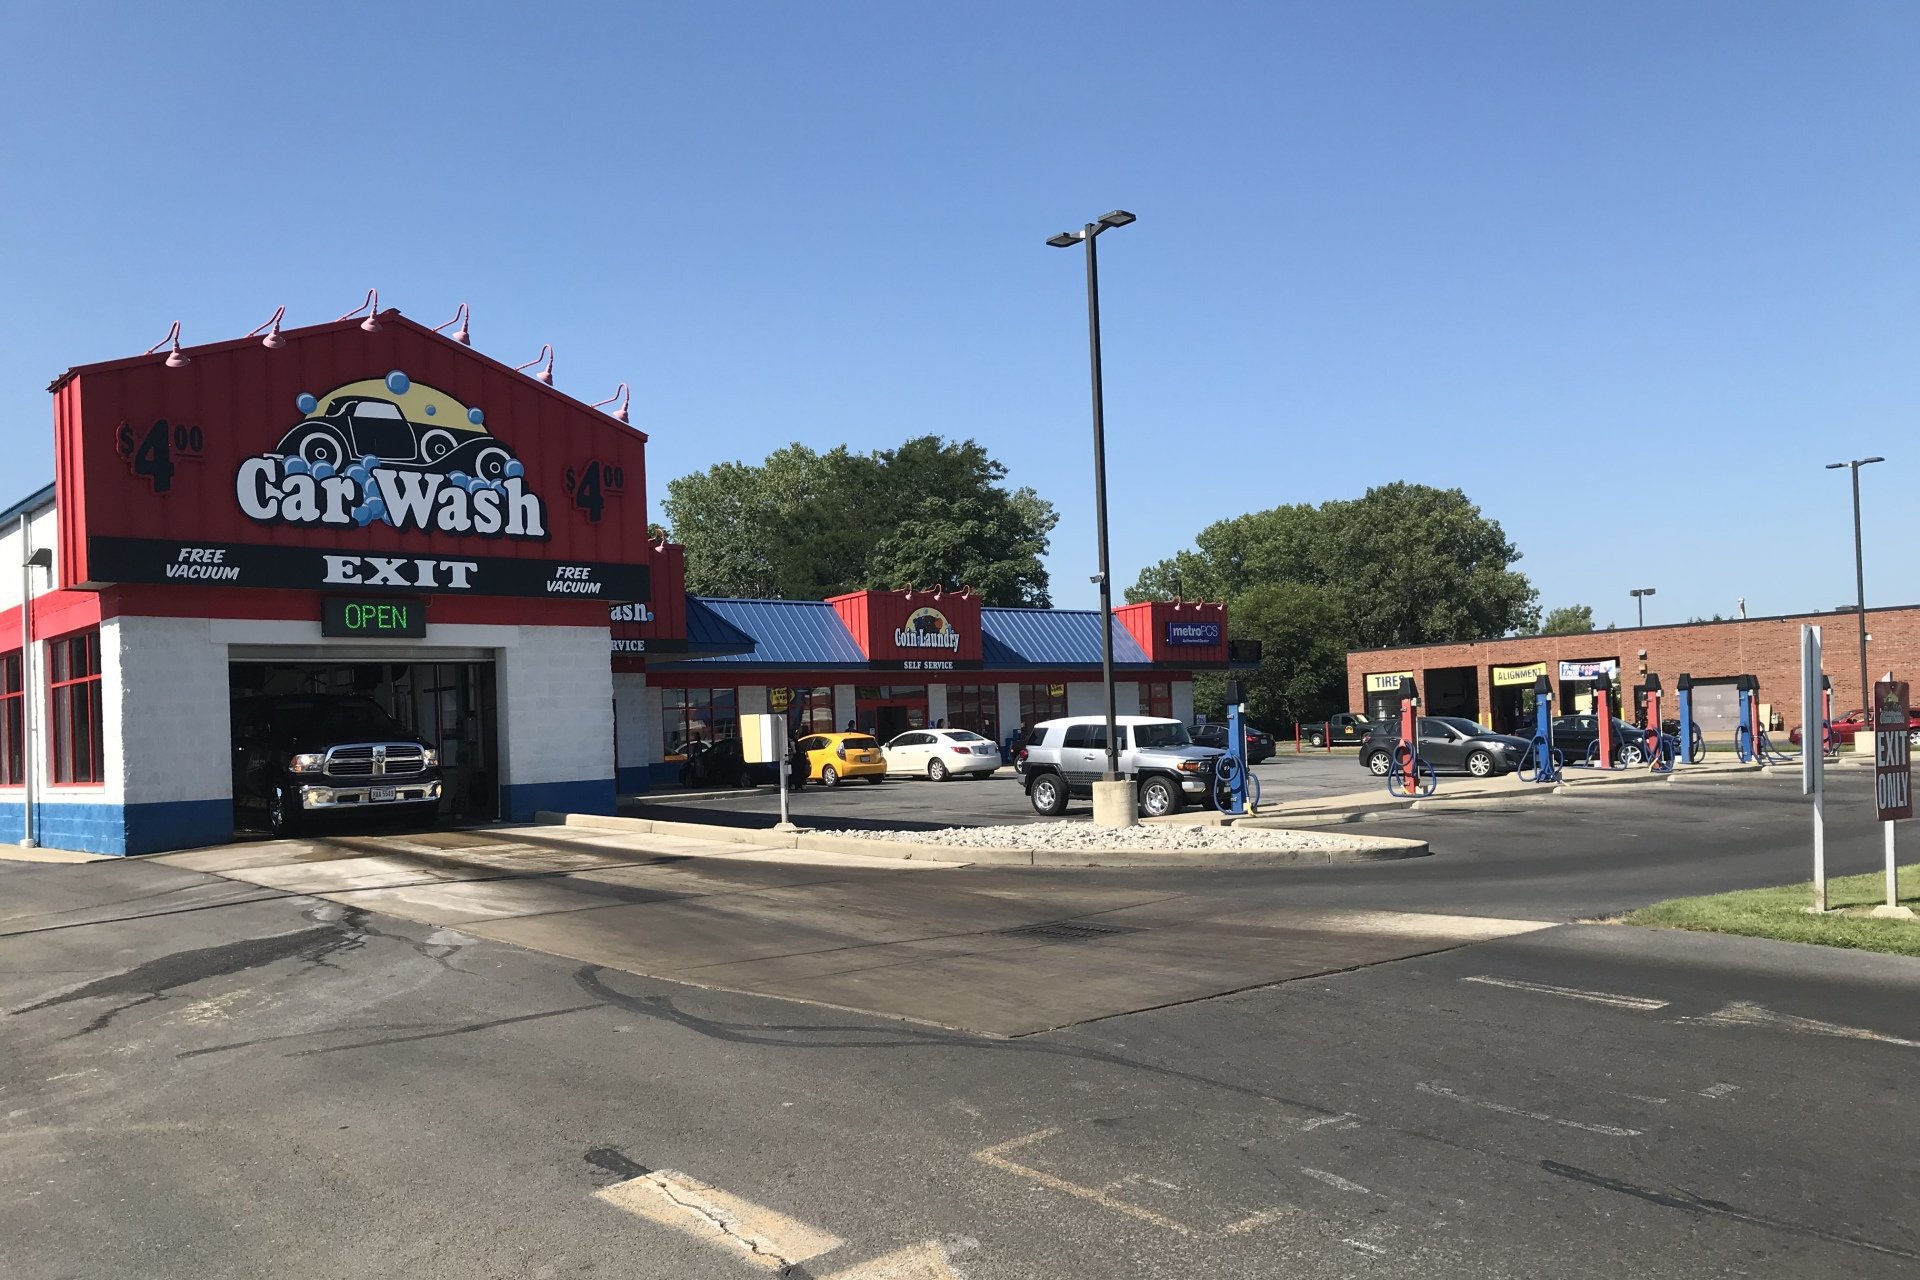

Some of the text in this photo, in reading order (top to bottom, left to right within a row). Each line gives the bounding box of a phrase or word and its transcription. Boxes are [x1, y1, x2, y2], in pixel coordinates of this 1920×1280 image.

[236, 457, 545, 537] Car Wash
[178, 547, 227, 563] FREE
[166, 563, 241, 581] VACUUM
[322, 554, 478, 589] EXIT
[555, 566, 592, 580] FREE
[546, 580, 602, 594] VACUUM
[345, 603, 408, 629] OPEN
[1172, 625, 1218, 637] metroPCS
[611, 640, 645, 651] RVICE
[895, 627, 960, 653] Coin Laundry
[903, 661, 954, 670] SELF SERVICE
[1497, 667, 1542, 681] ALIGNMENT
[1877, 730, 1908, 767] EXIT
[1878, 771, 1909, 810] ONLY
